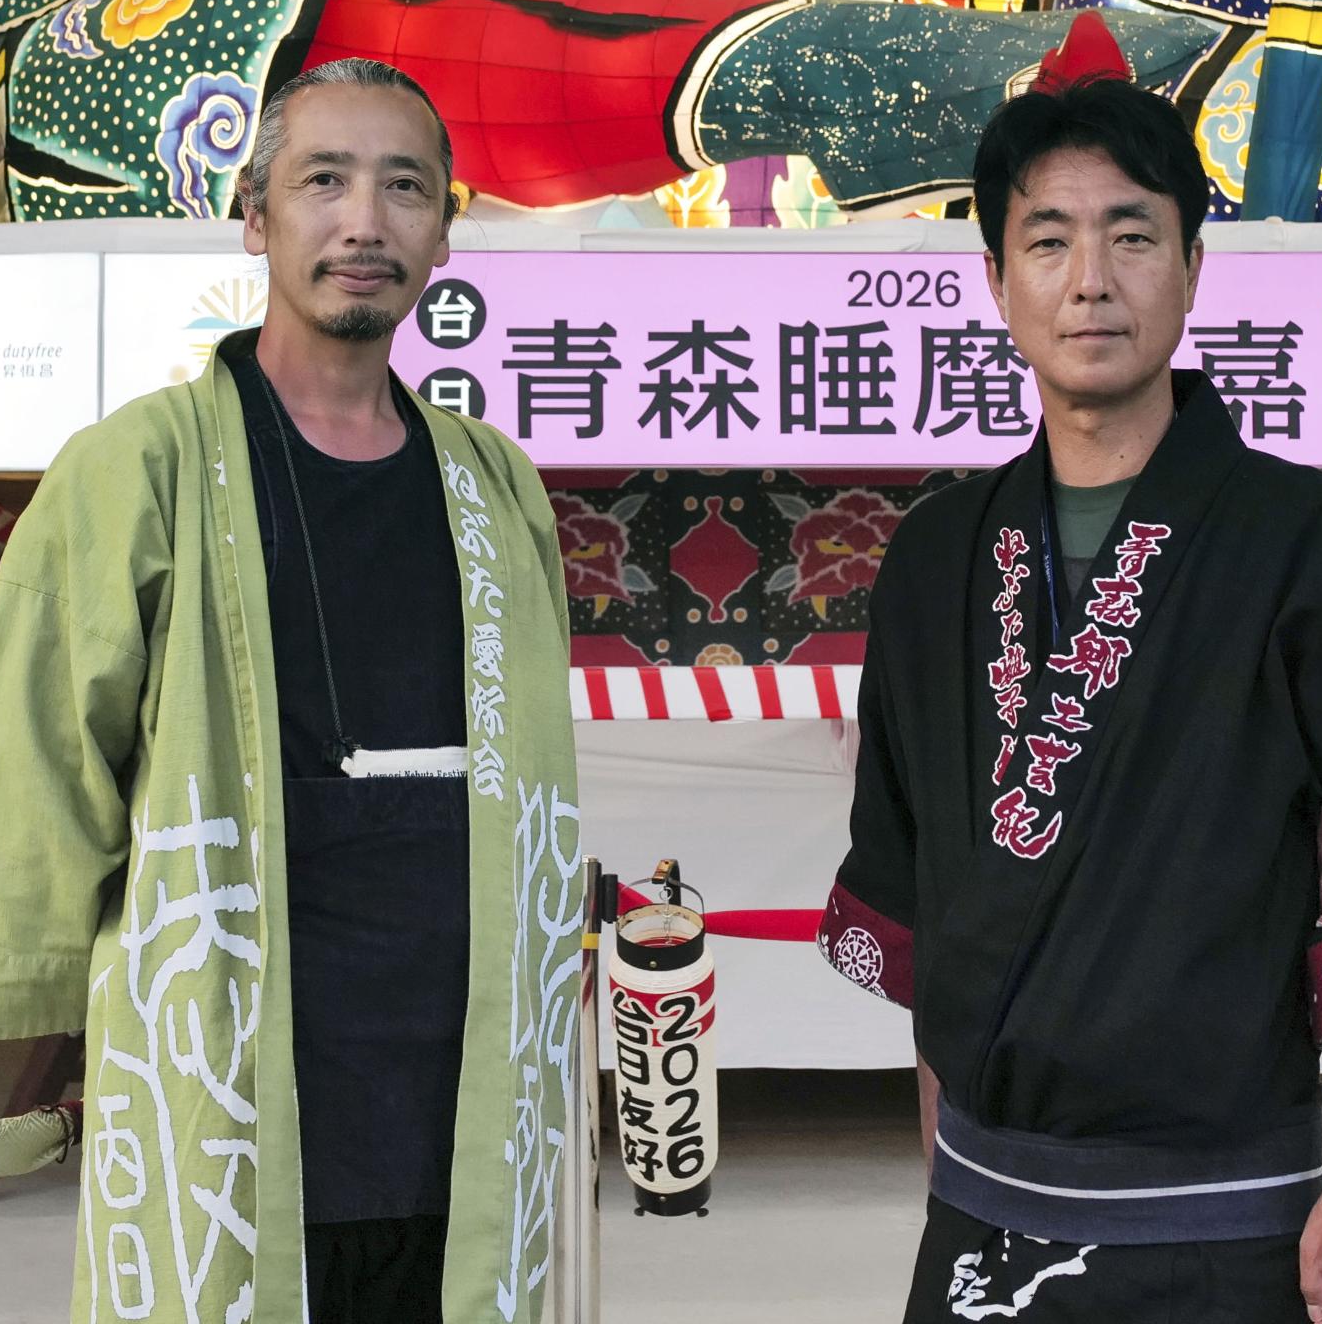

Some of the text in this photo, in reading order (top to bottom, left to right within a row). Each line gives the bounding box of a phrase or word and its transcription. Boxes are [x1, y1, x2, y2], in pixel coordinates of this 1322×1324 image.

[846, 270, 962, 308] 2026
[2, 342, 63, 361] dutyfree
[502, 319, 1307, 440] 青森睡魔嘉
[612, 990, 664, 1183] 台日友好
[660, 994, 705, 1180] 2026
